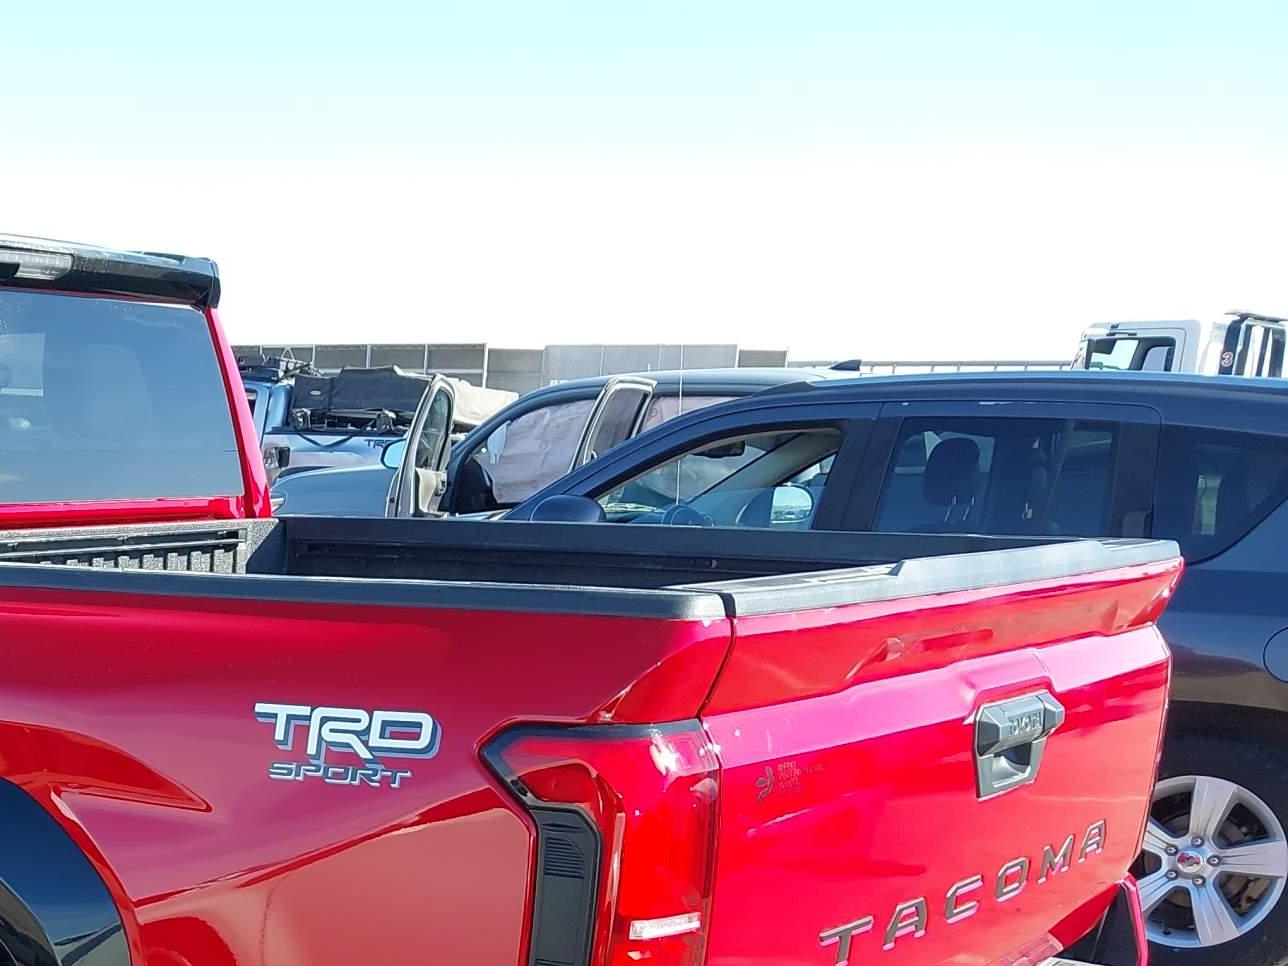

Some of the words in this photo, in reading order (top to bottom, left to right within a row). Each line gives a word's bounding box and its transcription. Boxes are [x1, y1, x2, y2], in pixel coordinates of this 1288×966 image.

[1221, 351, 1233, 367] 3
[253, 702, 442, 768] TRD
[269, 762, 413, 788] SPORT
